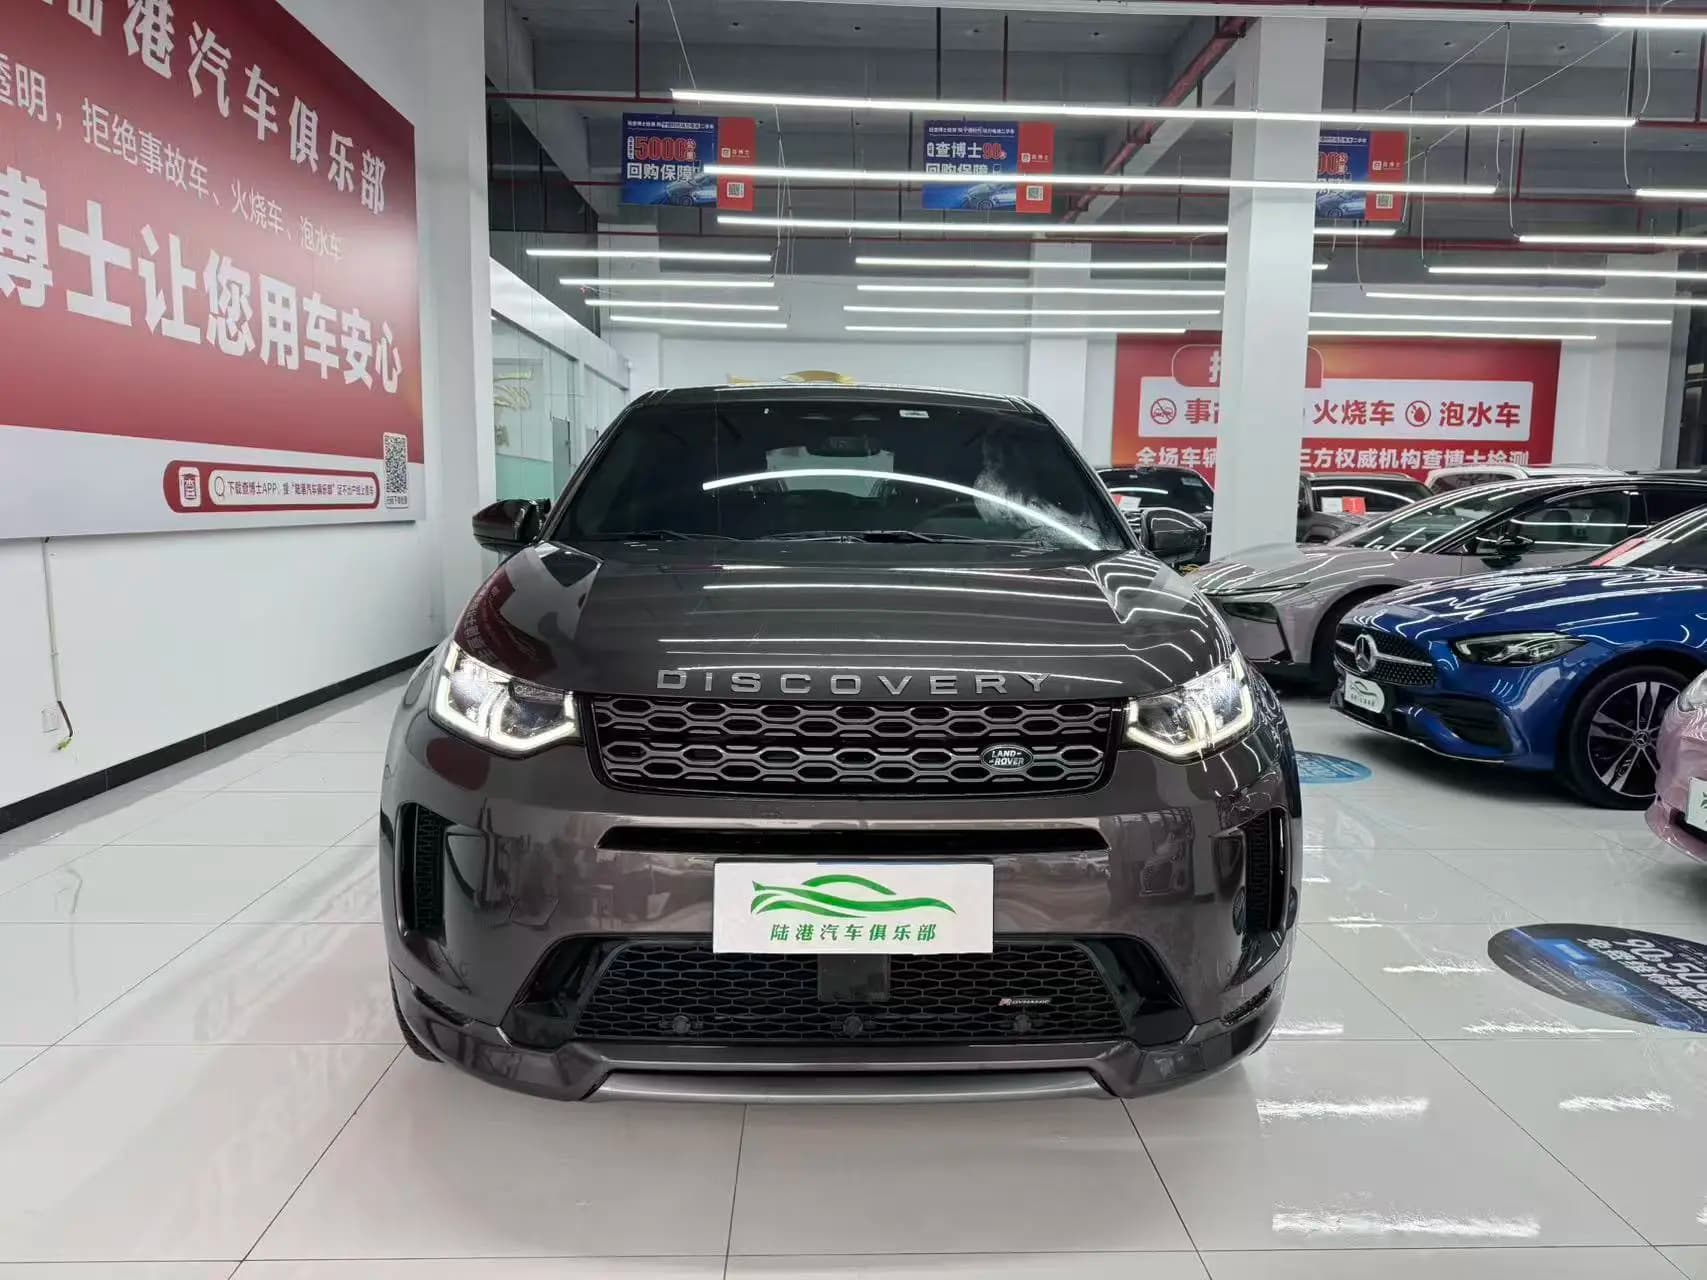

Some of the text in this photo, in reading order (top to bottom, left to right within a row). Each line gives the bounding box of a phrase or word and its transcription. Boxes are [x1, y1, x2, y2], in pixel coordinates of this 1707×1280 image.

[626, 162, 694, 181] 回购保障
[1184, 398, 1521, 428] 事 火烧车 泡水车
[656, 669, 1051, 696] DISCOVERY
[770, 923, 937, 942] 陆港汽车俱乐部
